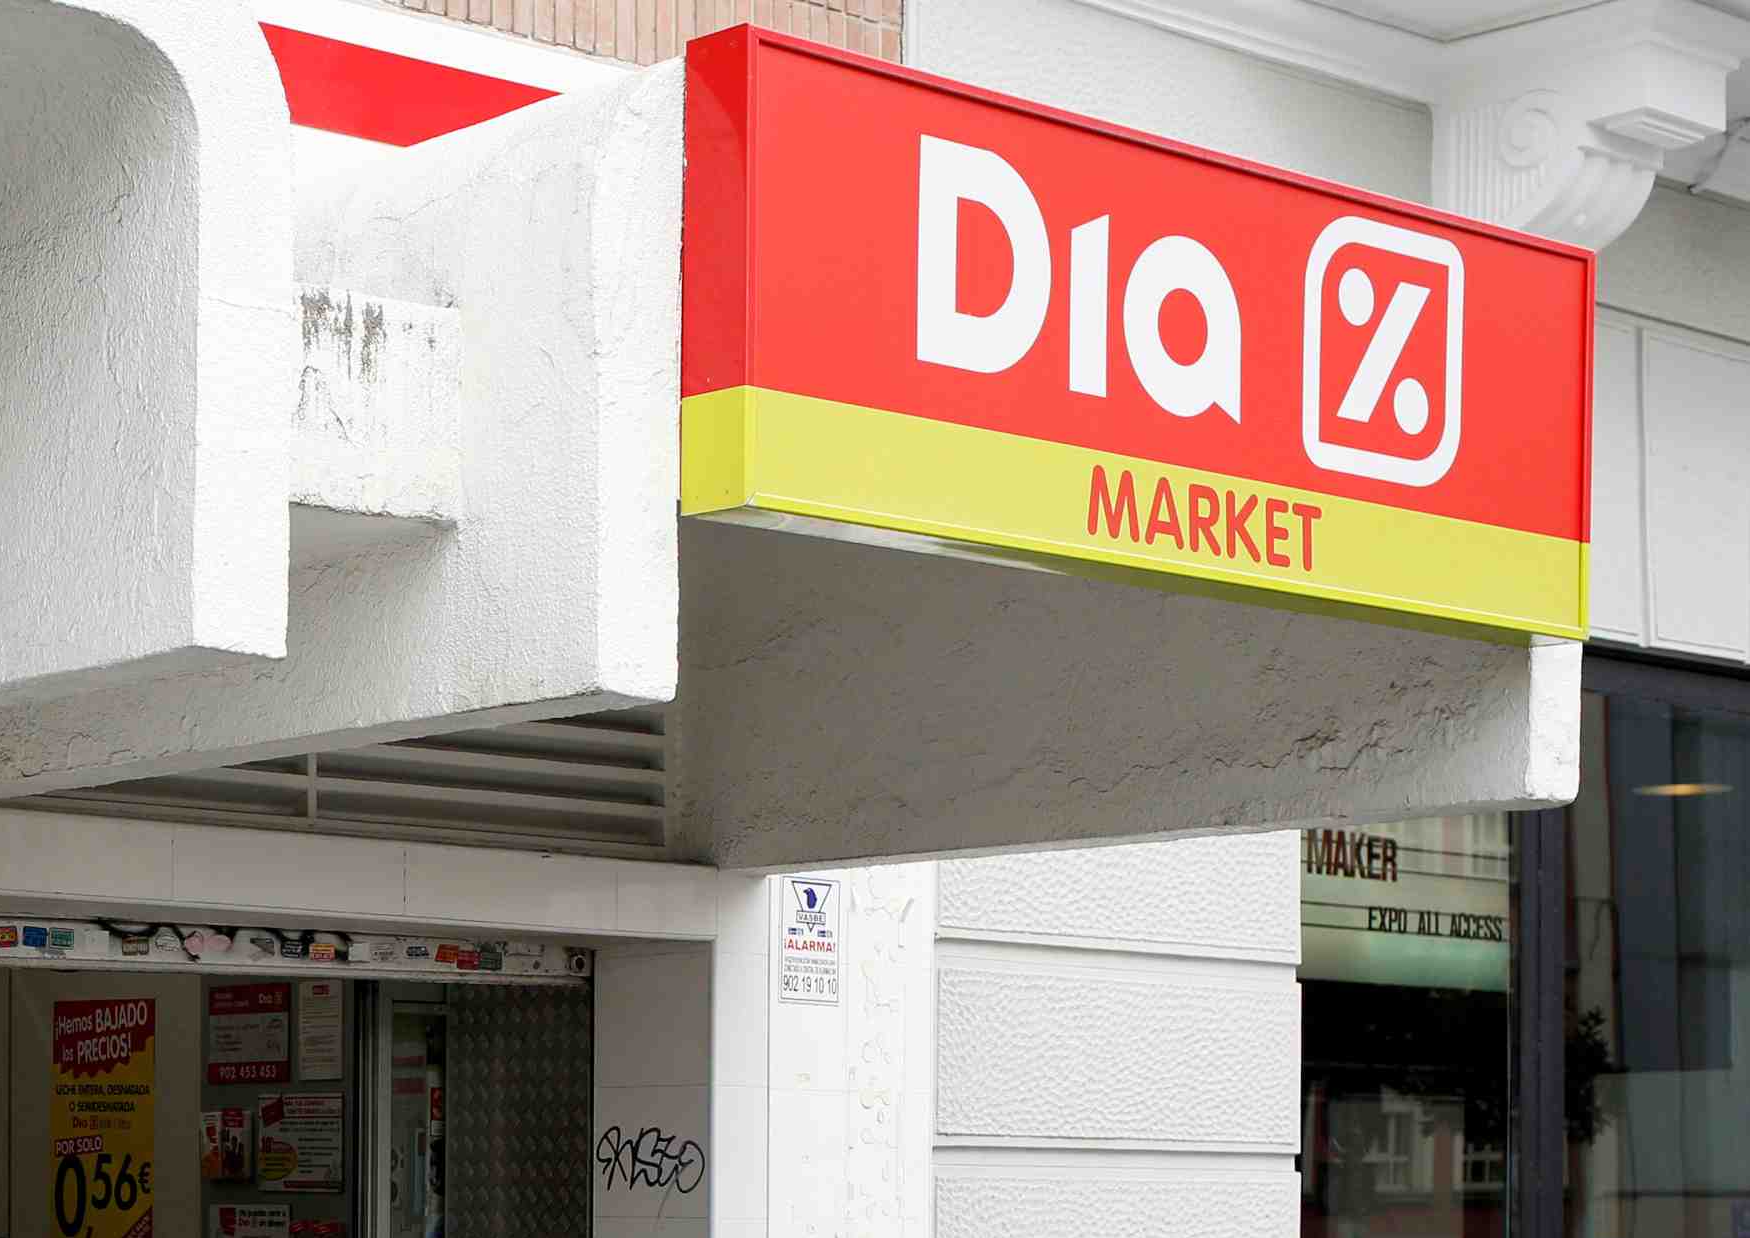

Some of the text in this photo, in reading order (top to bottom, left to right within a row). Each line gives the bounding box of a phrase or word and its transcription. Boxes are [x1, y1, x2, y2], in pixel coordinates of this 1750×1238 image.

[917, 134, 1241, 424] Dia
[1087, 464, 1322, 572] MARKET
[1307, 829, 1398, 882] MAKER
[1368, 907, 1502, 942] EXPO ALL ACCESS
[783, 975, 837, 995] 902 19 10 10
[95, 1001, 147, 1032] BAJADO
[77, 1032, 131, 1064] PRECIOS!
[56, 1137, 102, 1155] POR SOLO
